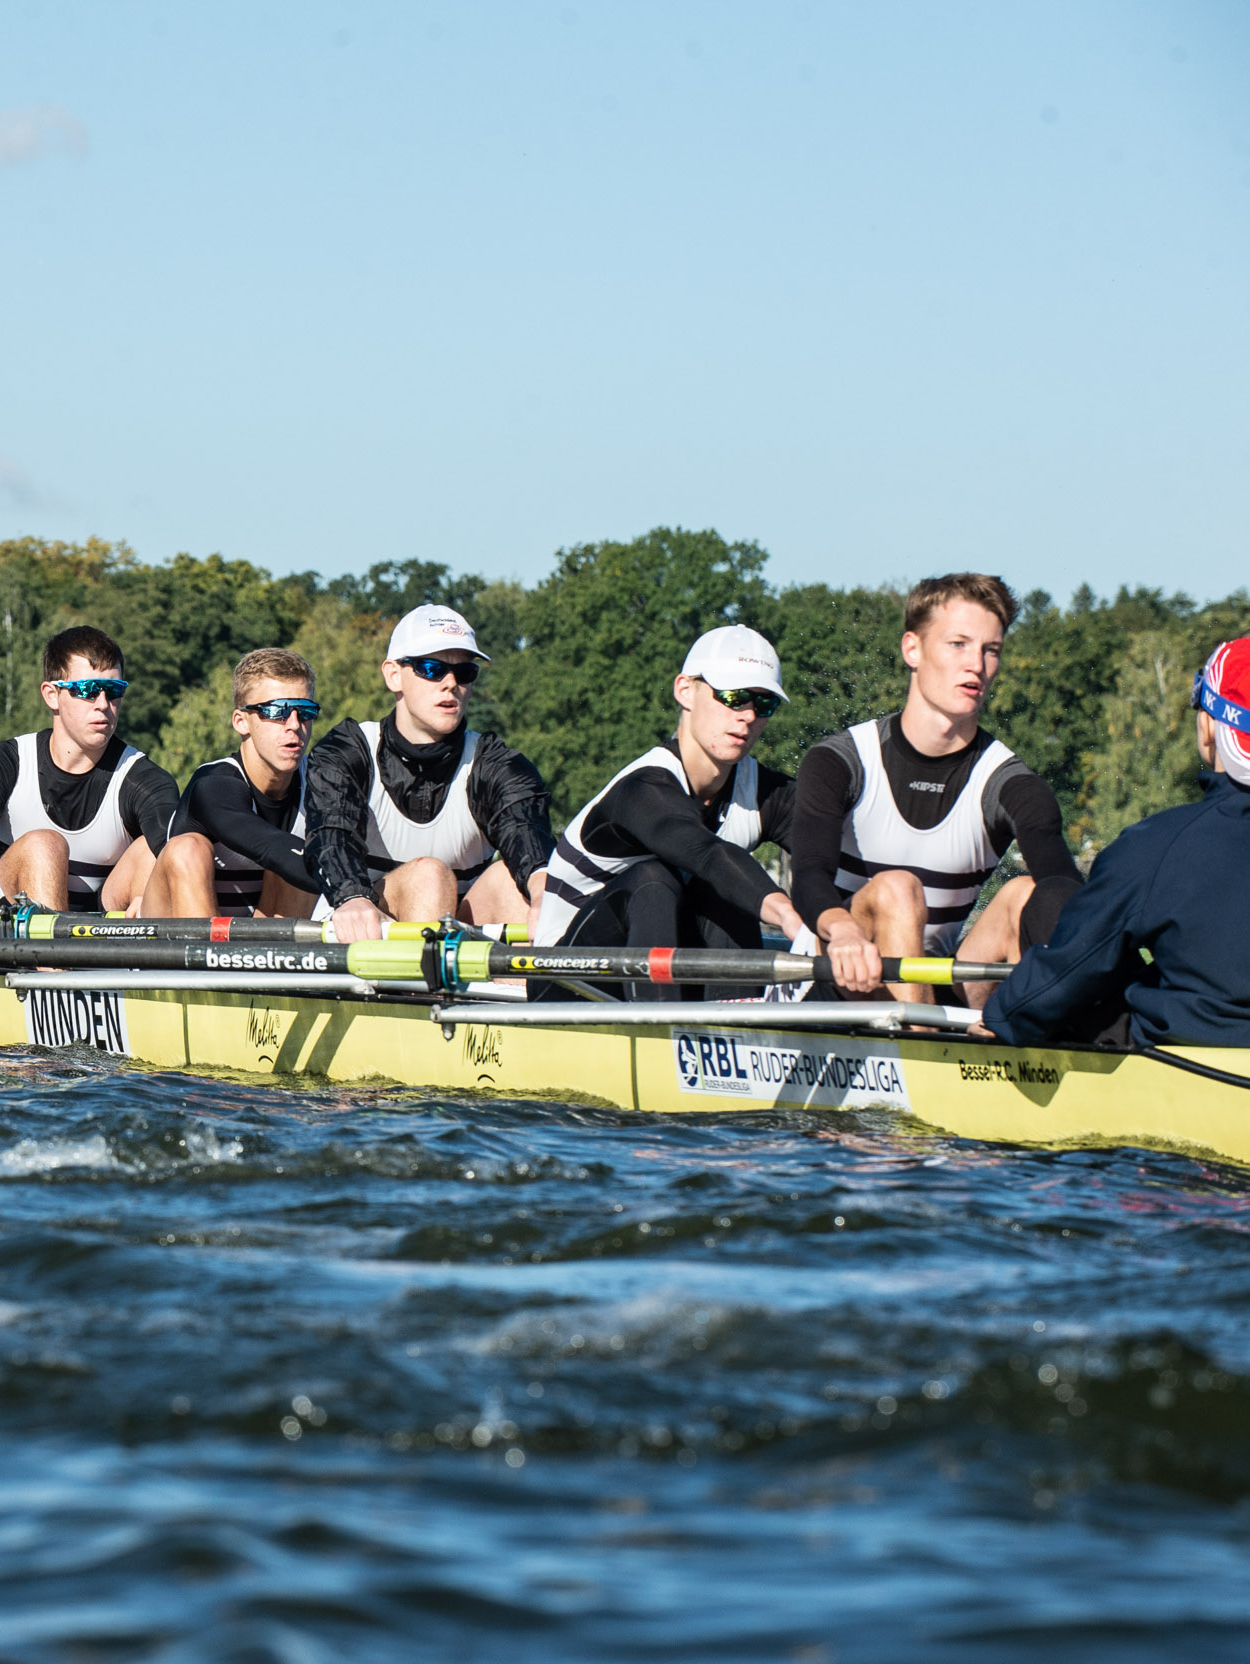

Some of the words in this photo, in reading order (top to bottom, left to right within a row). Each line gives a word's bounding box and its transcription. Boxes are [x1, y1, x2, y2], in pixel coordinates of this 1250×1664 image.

[1203, 690, 1216, 711] NK
[1222, 704, 1243, 726] NK
[91, 926, 146, 936] concept
[146, 926, 155, 935] 2
[206, 949, 328, 971] besselrc.de
[533, 957, 598, 969] concept
[599, 958, 610, 969] 2
[30, 989, 125, 1054] MINDEN
[699, 1036, 749, 1079] RBL
[750, 1051, 904, 1094] RUDER-BUNDESLIGA
[1018, 1061, 1061, 1084] Minden
